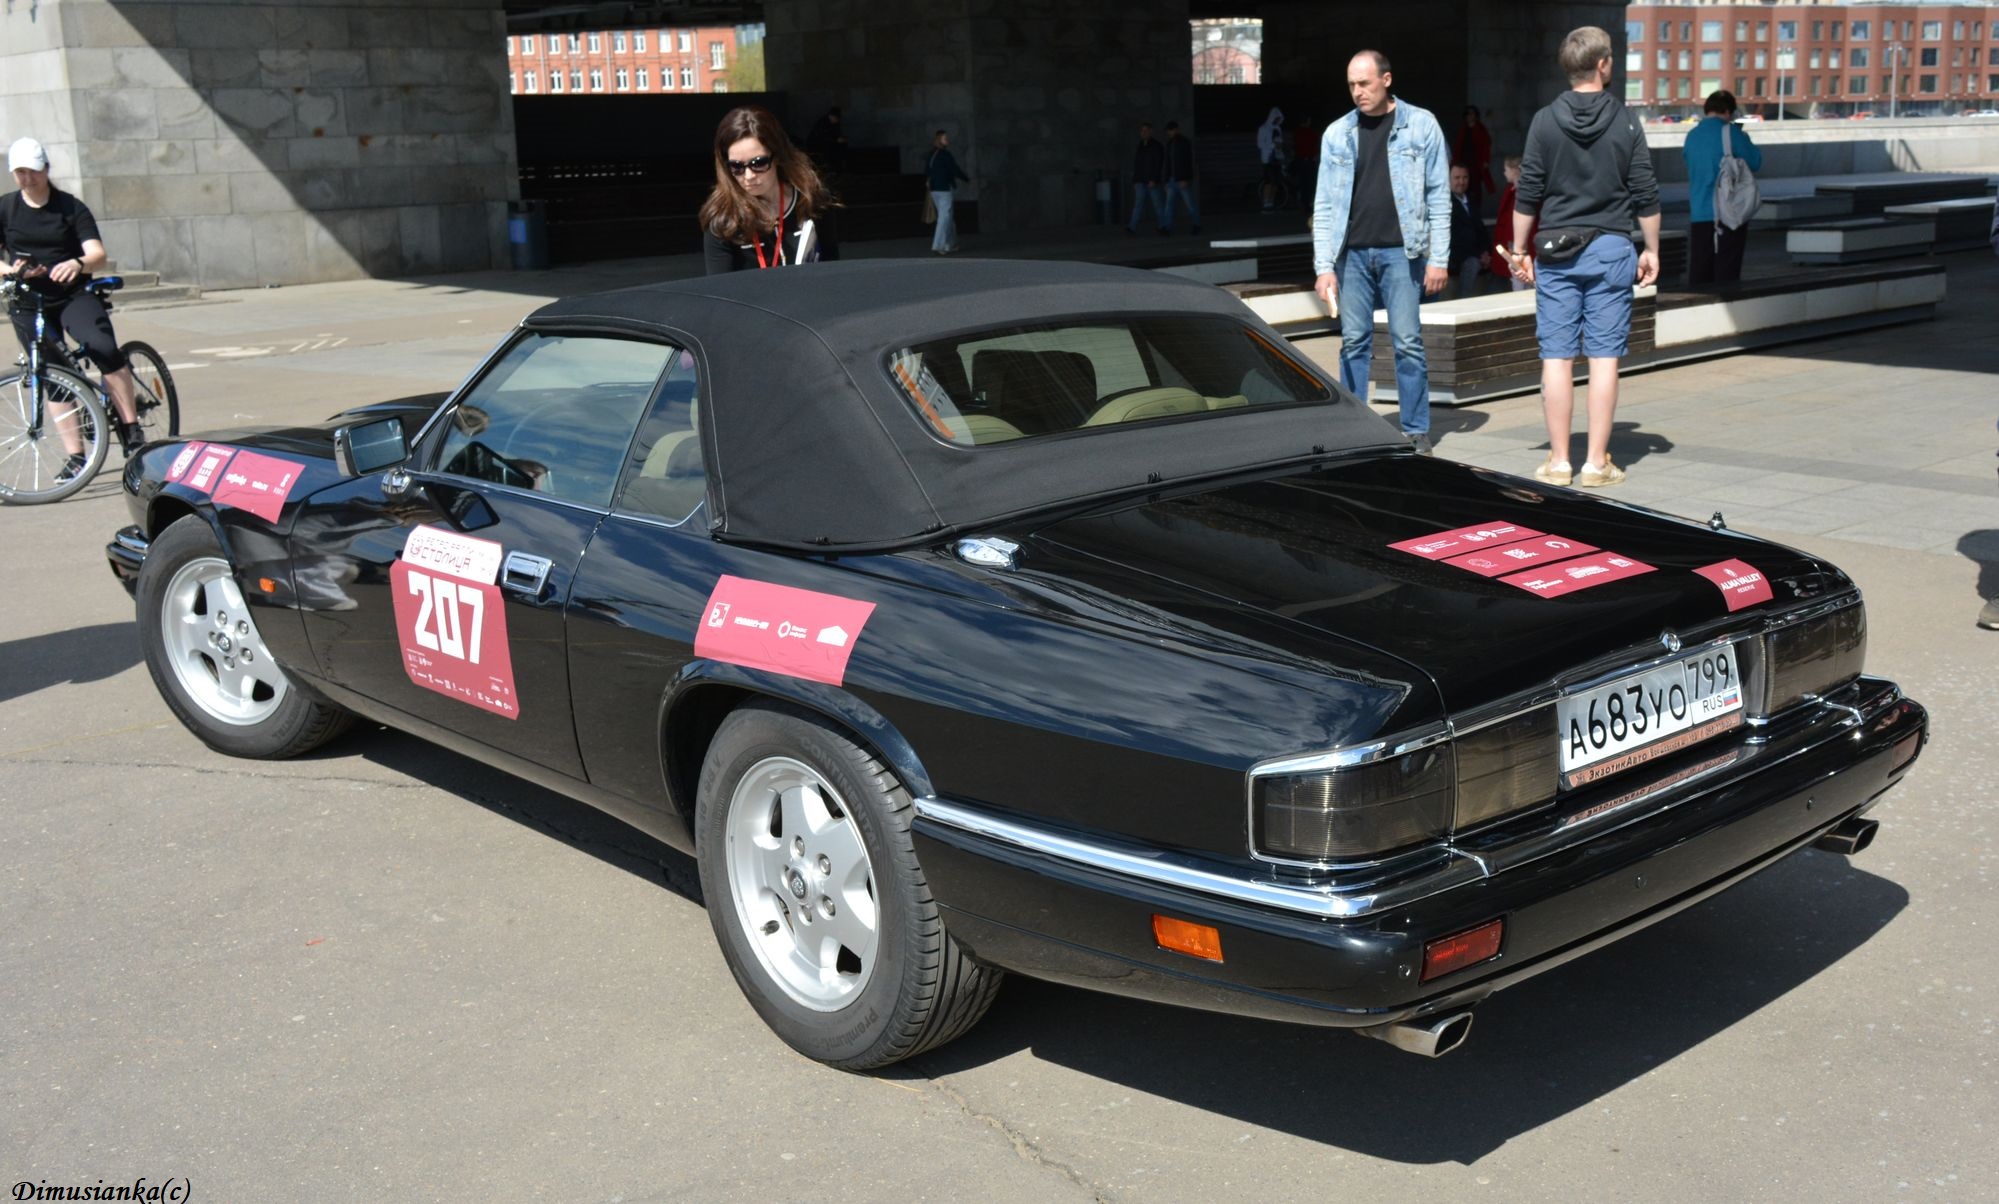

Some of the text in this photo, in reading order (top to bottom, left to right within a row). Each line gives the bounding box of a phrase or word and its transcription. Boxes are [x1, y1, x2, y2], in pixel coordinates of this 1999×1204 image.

[1720, 572, 1762, 591] ALMA VALLEY
[407, 569, 484, 665] 207
[1569, 683, 1687, 760] А683УО
[1687, 652, 1730, 700] 799
[1702, 694, 1724, 714] RUS
